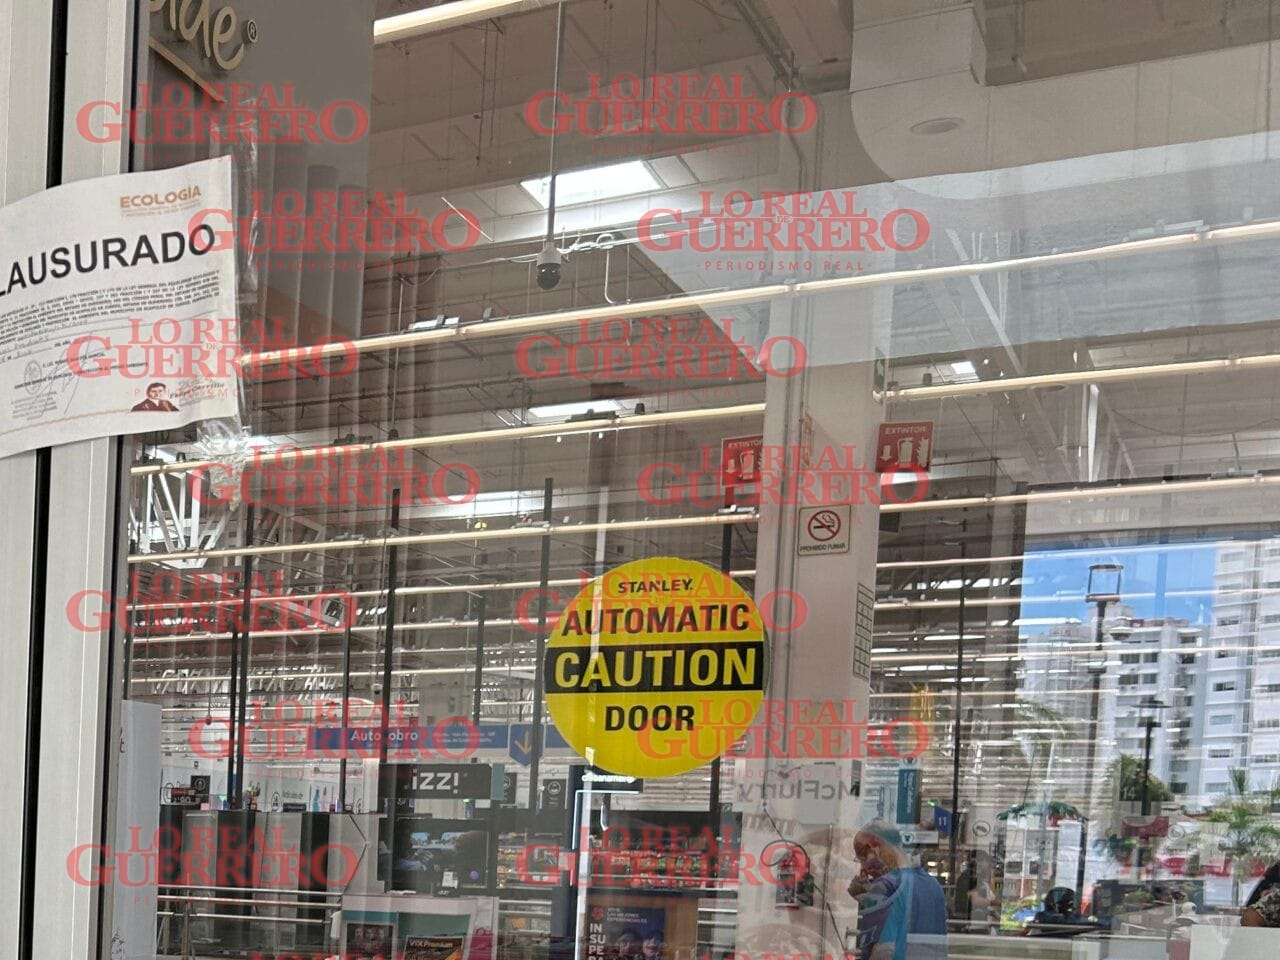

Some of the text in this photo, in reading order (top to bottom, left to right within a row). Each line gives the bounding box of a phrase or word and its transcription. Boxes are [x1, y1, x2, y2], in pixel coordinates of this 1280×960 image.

[120, 184, 201, 210] ECOLOGÍA
[885, 426, 927, 434] EXTINTOR
[562, 604, 749, 636] AUTOMATIC
[555, 648, 755, 688] CAUTION
[605, 705, 694, 731] DOOR
[351, 730, 418, 741] Autoobro
[590, 923, 602, 933] IN
[590, 934, 605, 944] SU
[589, 945, 604, 955] PE
